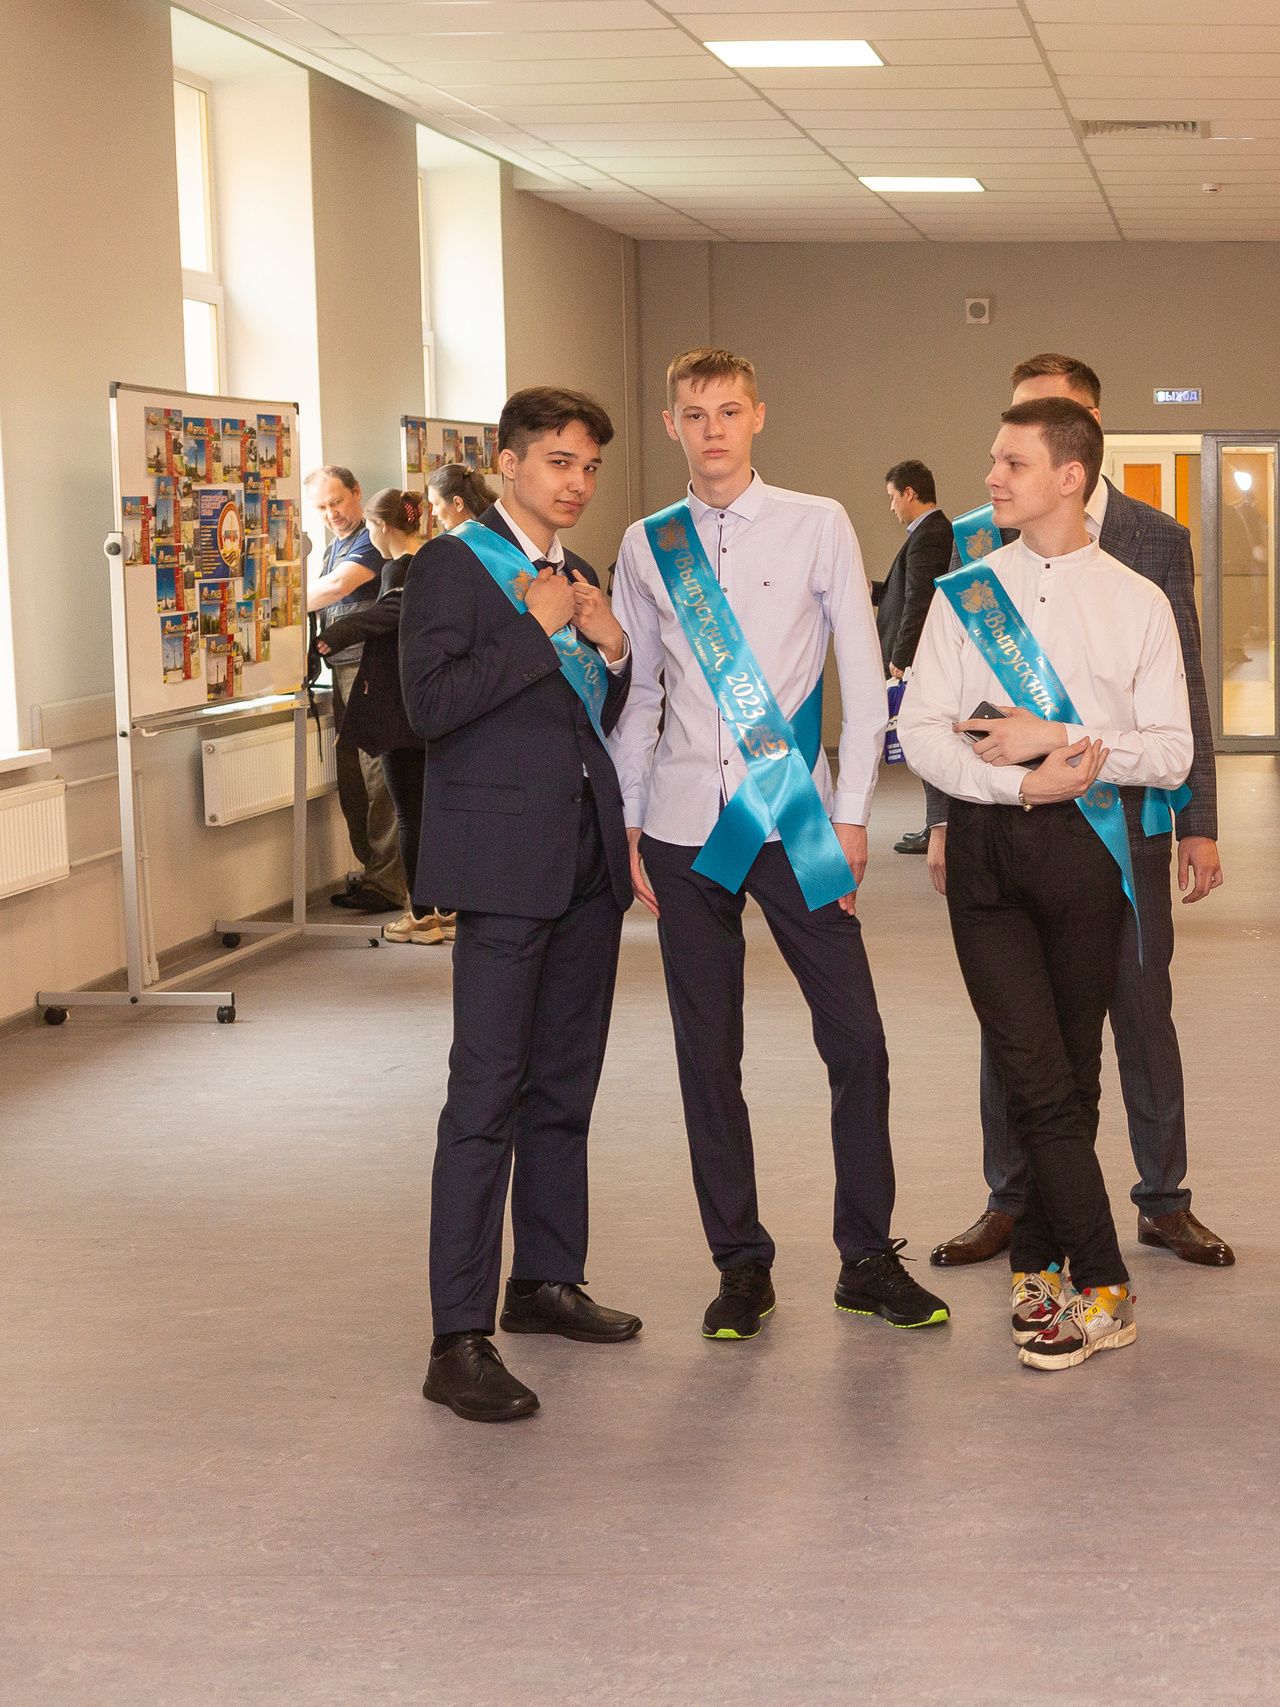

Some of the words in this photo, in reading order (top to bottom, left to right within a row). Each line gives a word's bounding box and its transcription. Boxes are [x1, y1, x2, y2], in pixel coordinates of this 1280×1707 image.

[1156, 390, 1199, 402] ВЫХОД
[674, 550, 734, 671] Выпускник
[725, 671, 767, 720] 2023
[983, 608, 1060, 722] Выпускник
